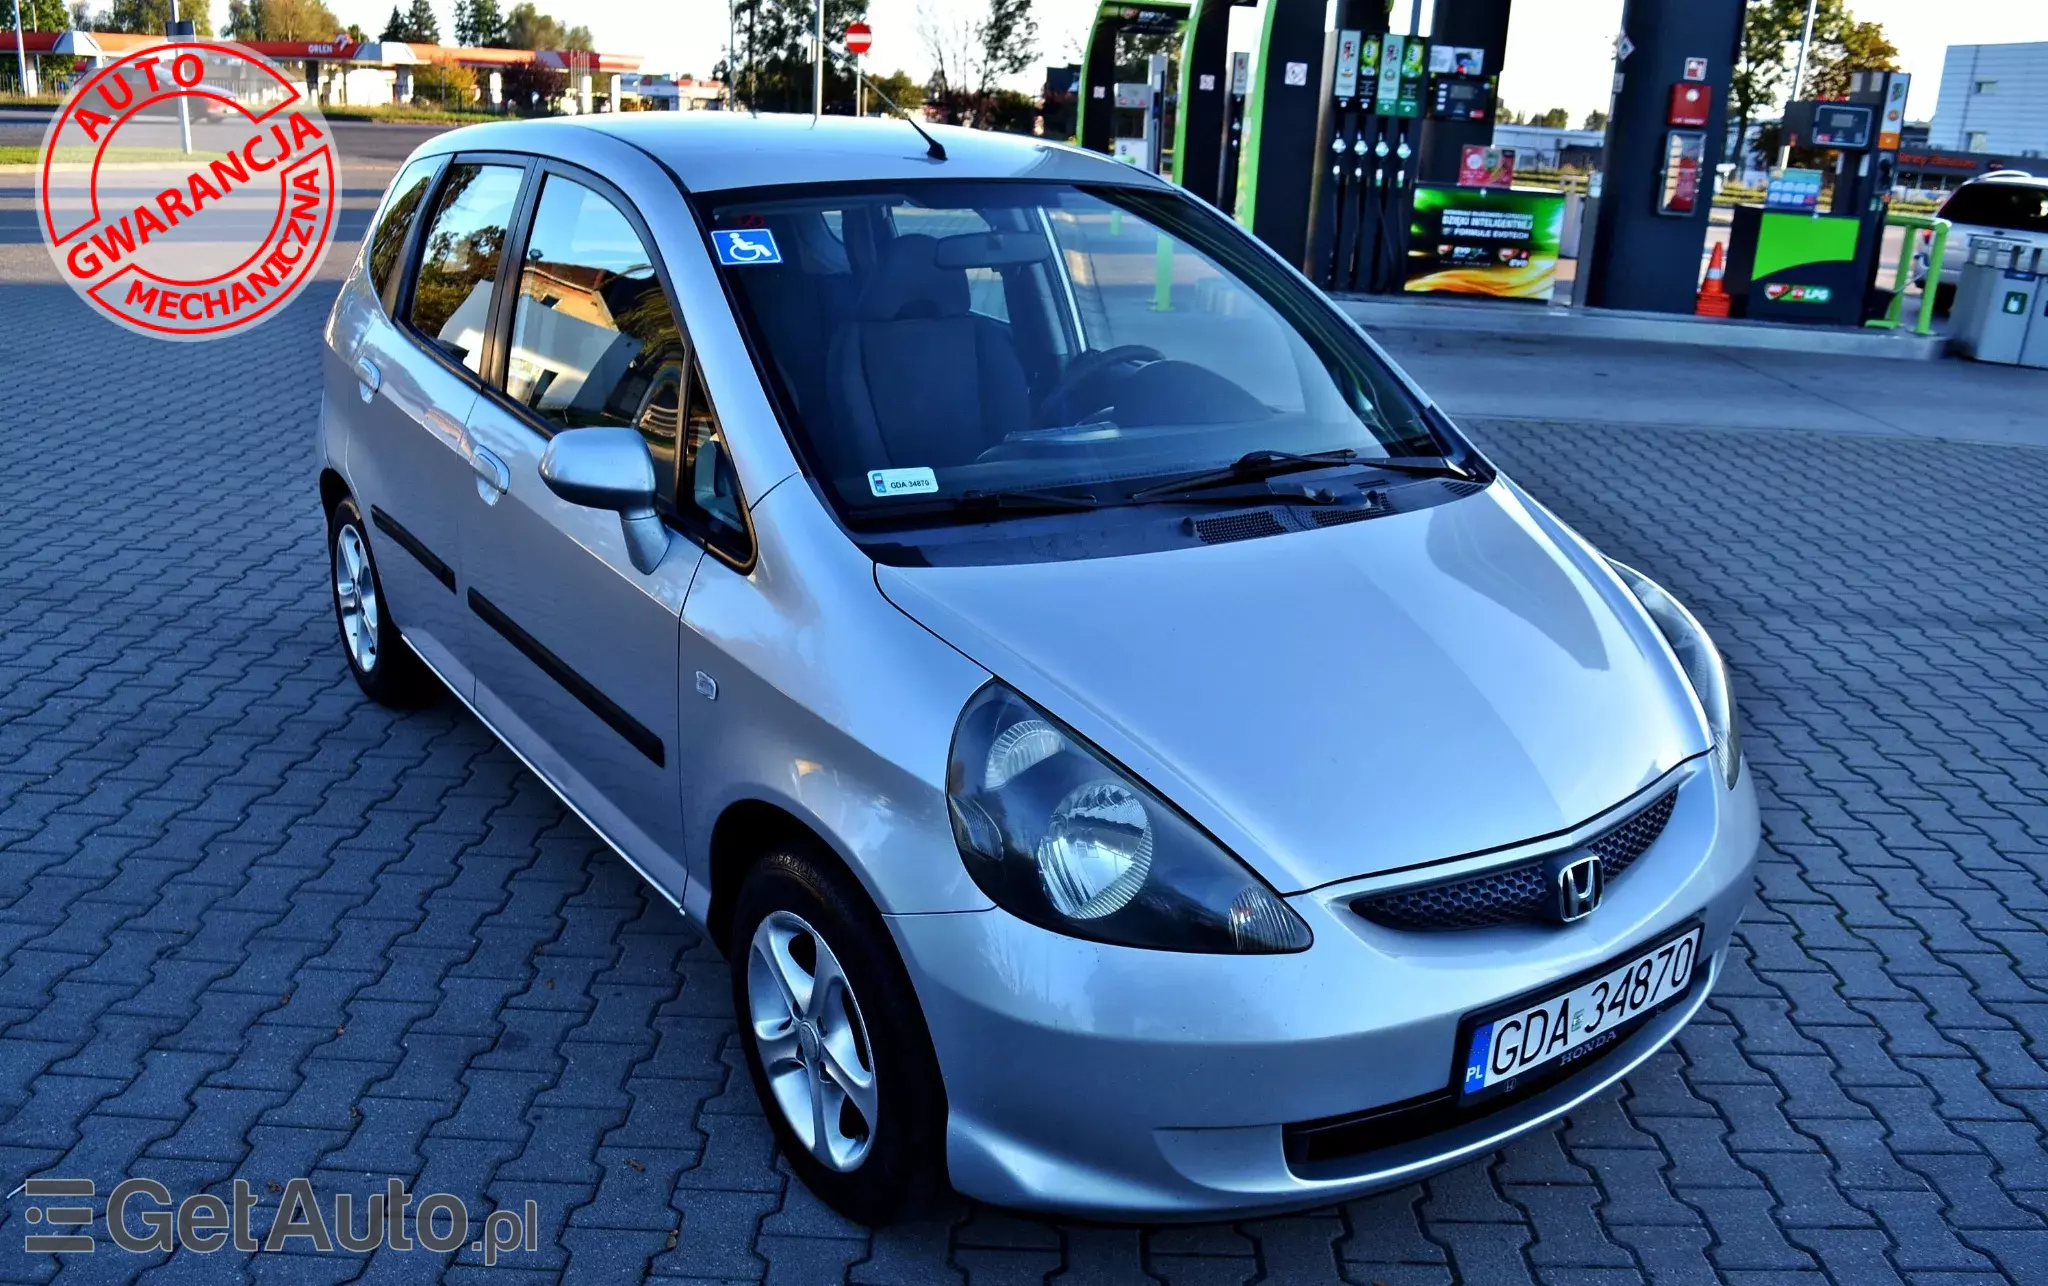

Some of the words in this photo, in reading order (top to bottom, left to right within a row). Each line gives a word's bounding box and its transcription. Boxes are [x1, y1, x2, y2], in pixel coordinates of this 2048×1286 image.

[308, 44, 333, 54] ORLEN
[1804, 288, 1829, 301] LPG
[890, 481, 908, 489] GDA
[908, 479, 930, 488] 34870
[1491, 997, 1570, 1076] GDA
[1584, 937, 1694, 1034] 34870
[1559, 1030, 1617, 1067] HONDA
[1465, 1066, 1484, 1083] PL
